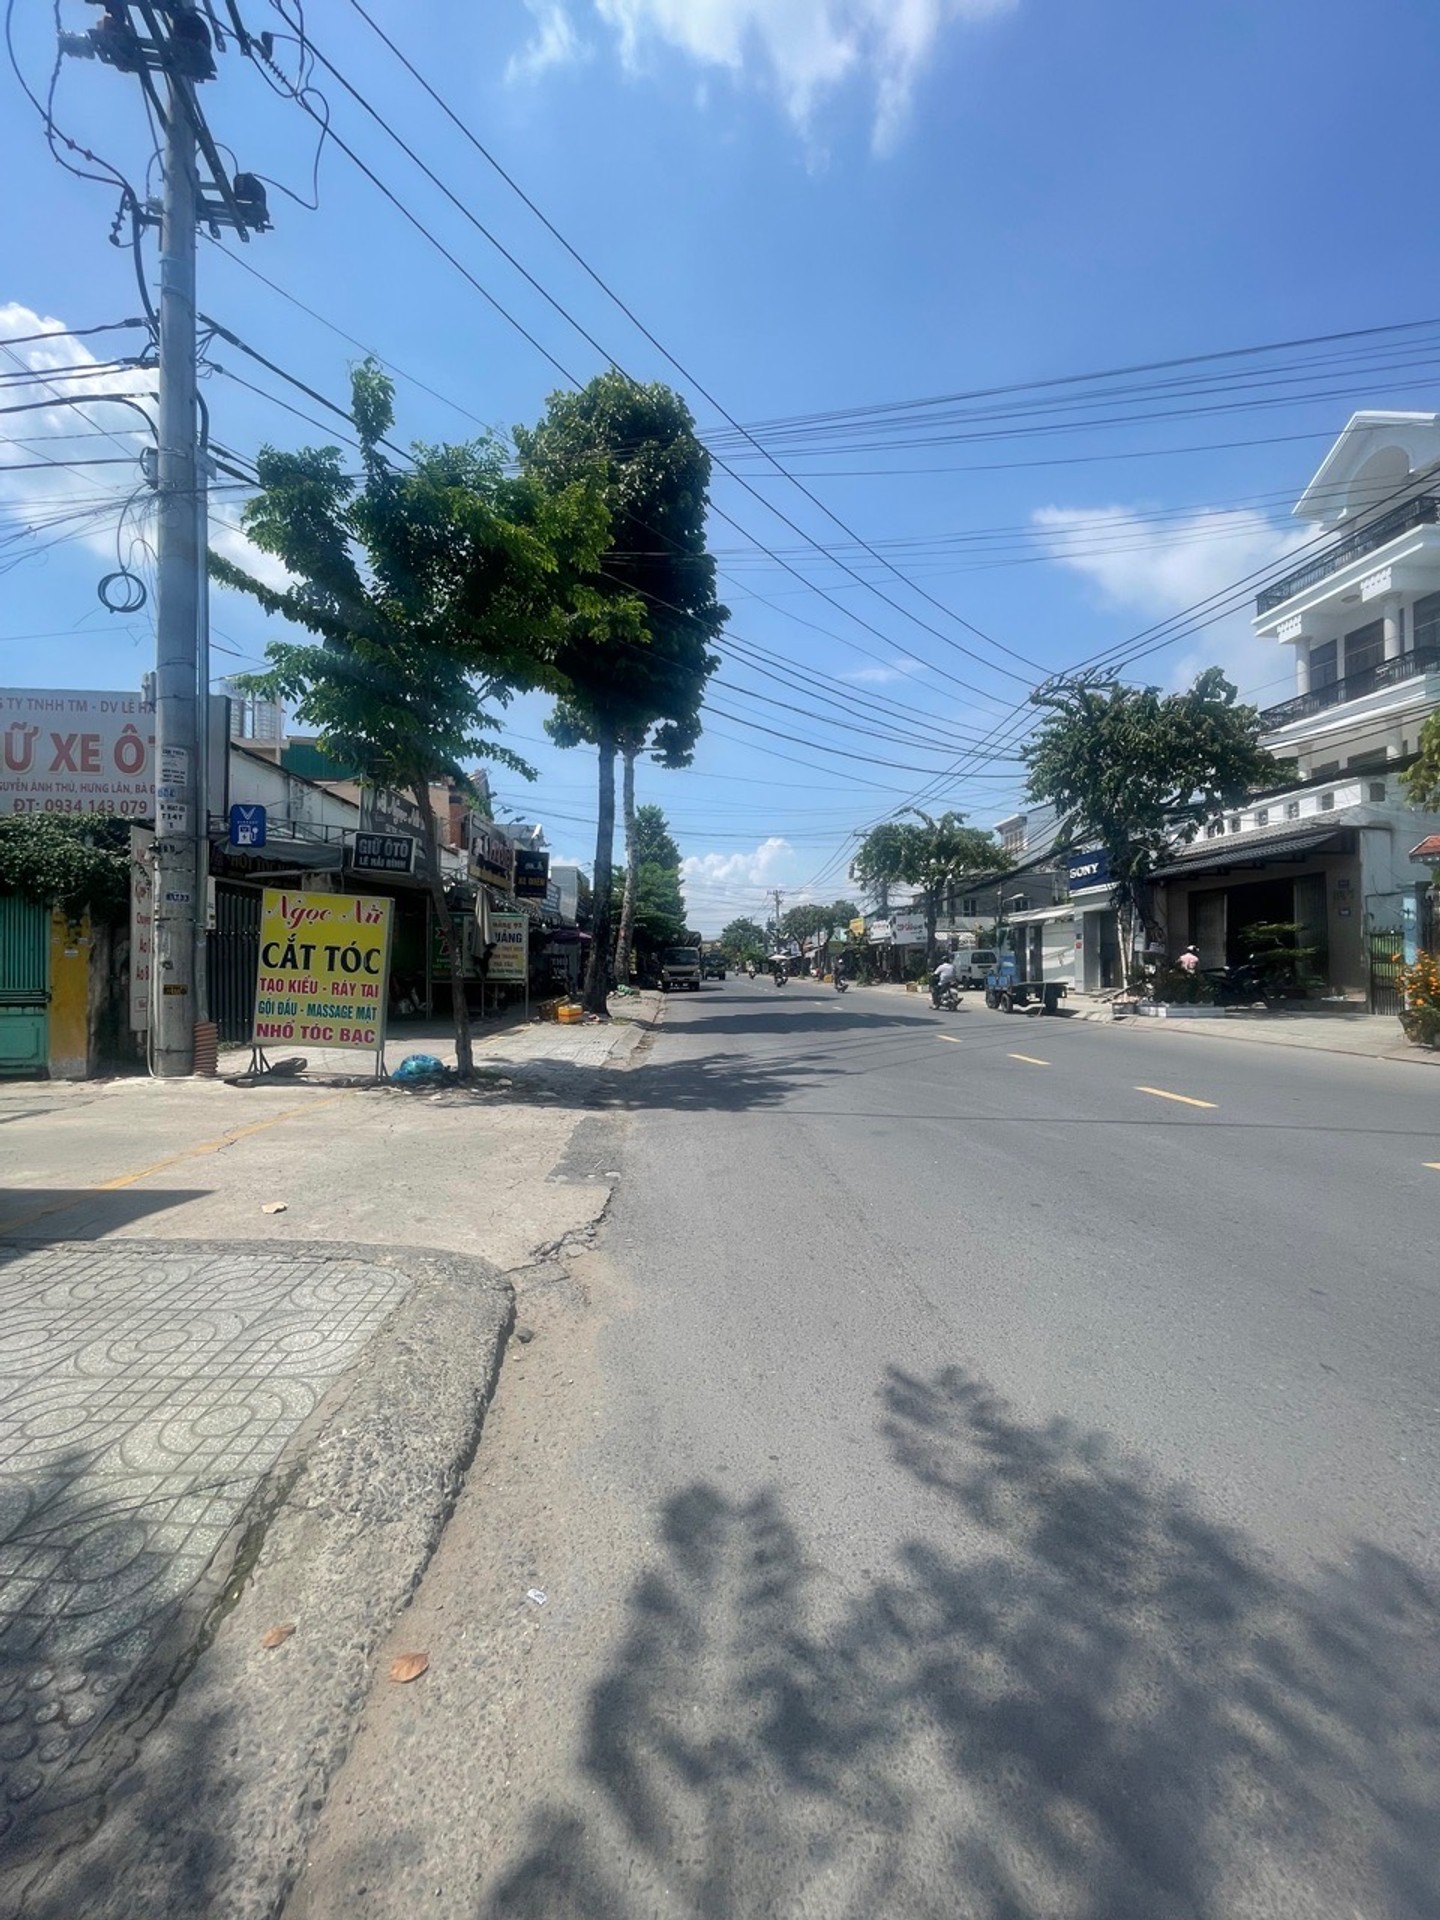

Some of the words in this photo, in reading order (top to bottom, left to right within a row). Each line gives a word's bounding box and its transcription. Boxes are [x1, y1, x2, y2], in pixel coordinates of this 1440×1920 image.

[6, 697, 23, 710] TY
[27, 698, 64, 711] TNHH
[68, 699, 88, 713] TM
[100, 701, 118, 713] DV
[48, 732, 101, 773] XE
[13, 798, 40, 813] ĐT:
[45, 799, 82, 814] 0934
[89, 800, 115, 815] 143
[120, 800, 147, 815] 079
[358, 837, 382, 856] GIỮ
[384, 838, 409, 858] ÔTÔ
[1069, 862, 1099, 879] SONY
[262, 933, 316, 971] CẮT
[323, 940, 381, 975] TÓC
[260, 977, 284, 996] TẠO
[361, 983, 379, 998] TAI
[258, 998, 275, 1018] GỘI
[307, 1003, 354, 1020] MASSAGE
[300, 1023, 334, 1041] TÓC
[340, 1028, 375, 1046] BẠC
